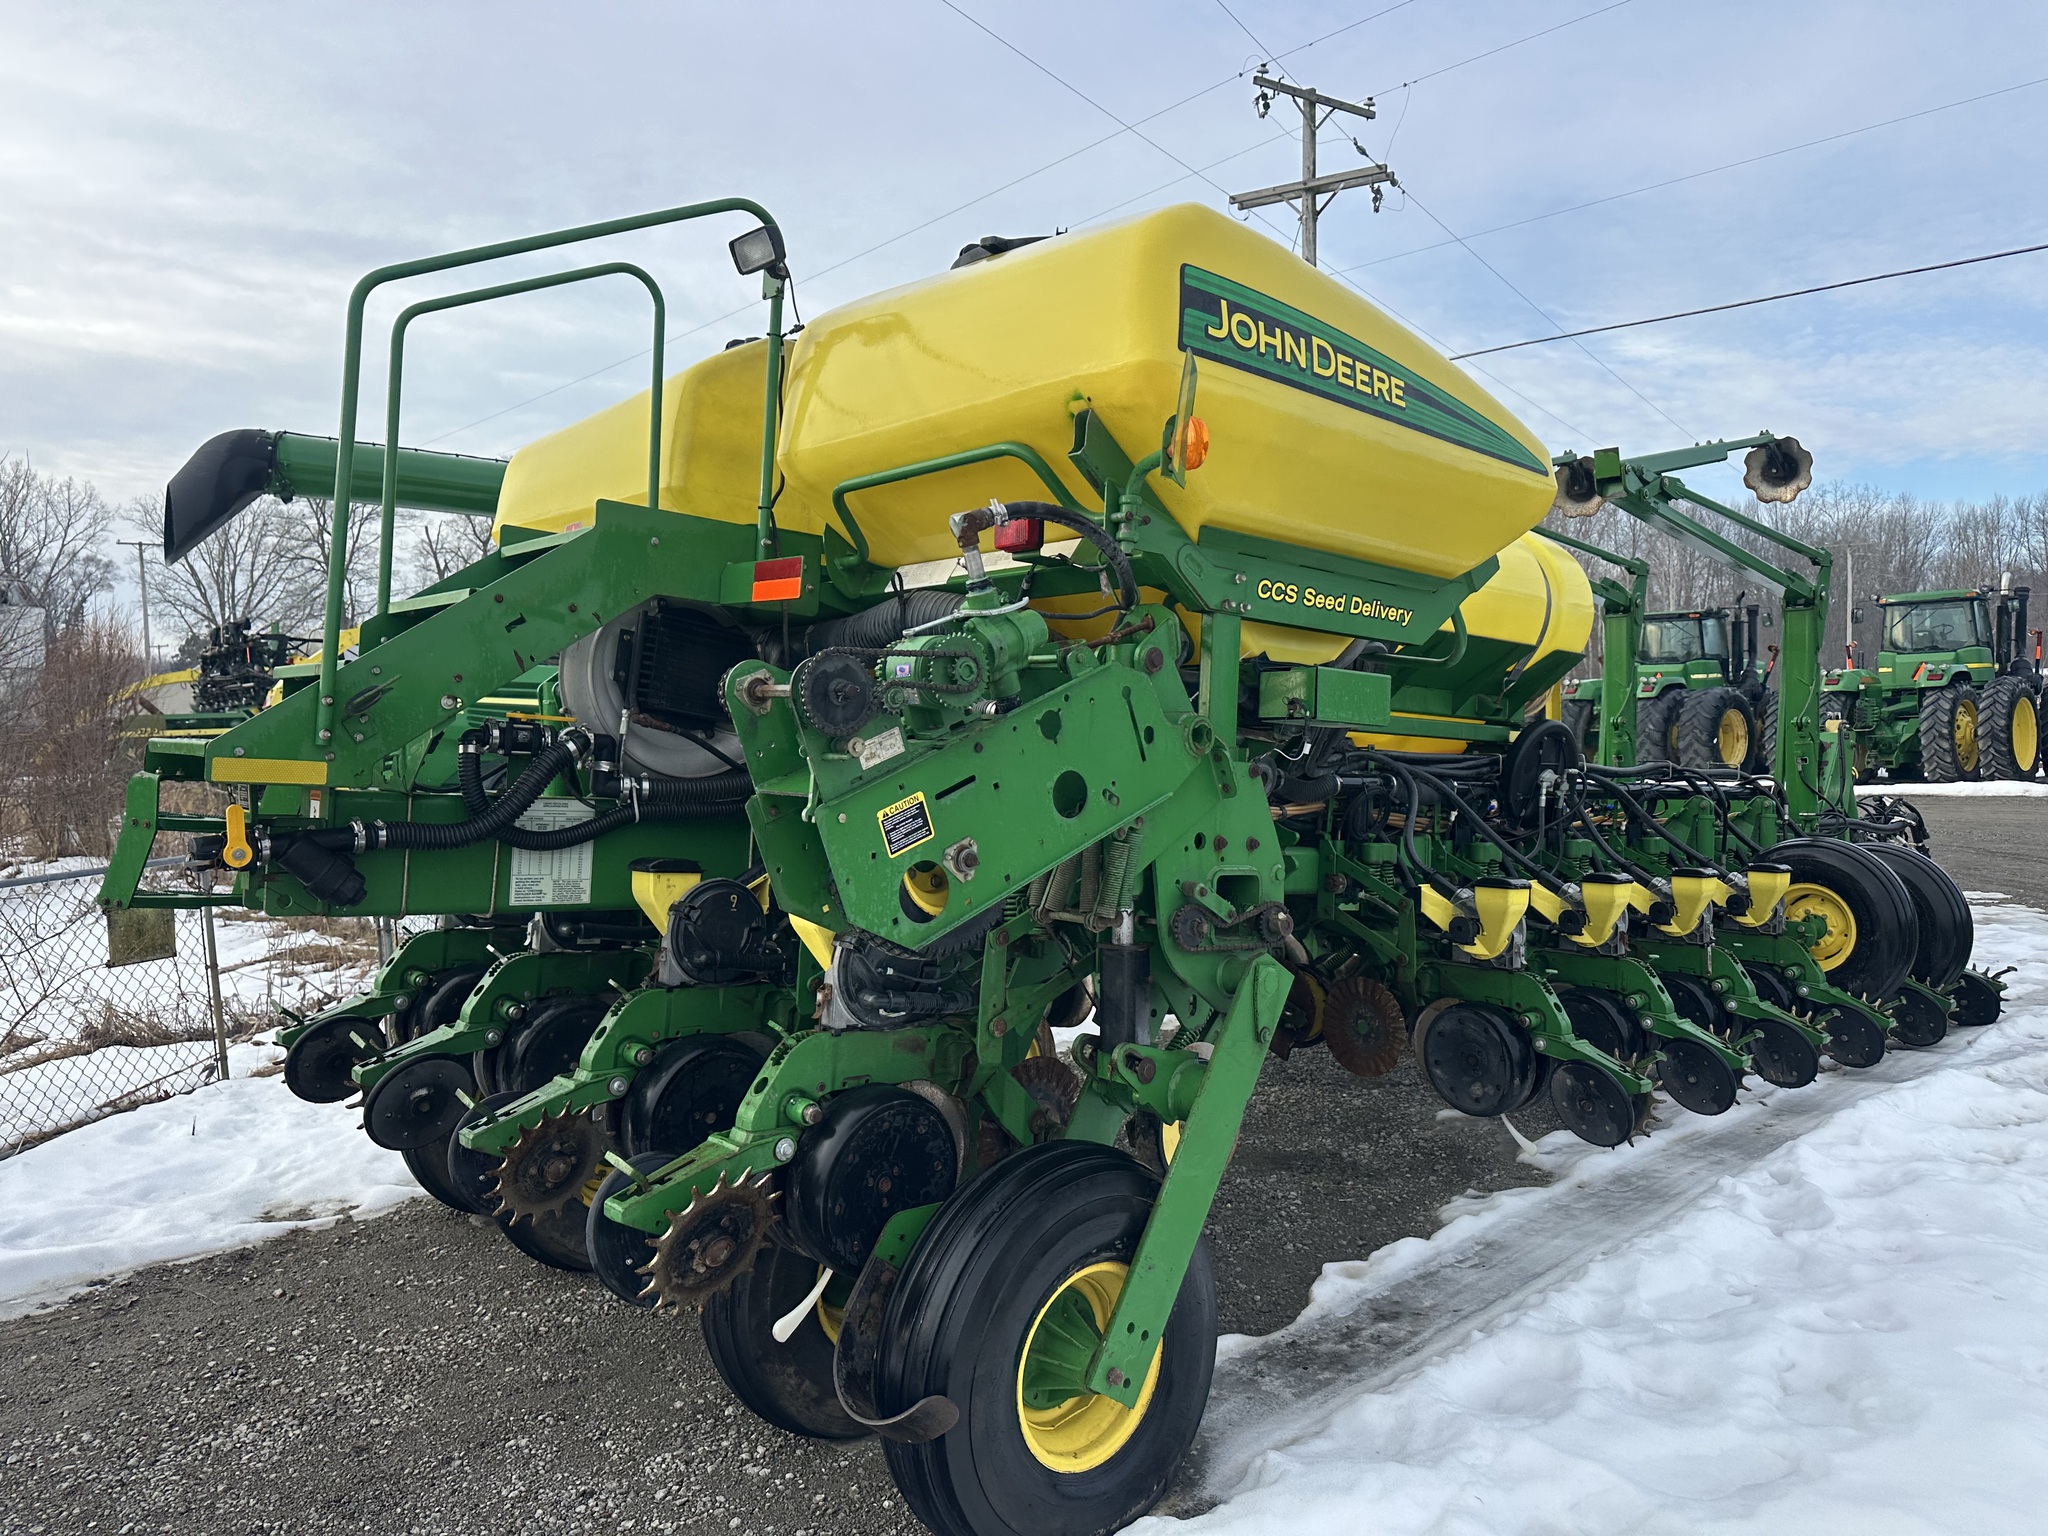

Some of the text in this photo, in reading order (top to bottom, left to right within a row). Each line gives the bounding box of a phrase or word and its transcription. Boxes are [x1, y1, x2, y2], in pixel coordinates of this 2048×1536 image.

[1208, 299, 1406, 408] JOHN DEERE
[1257, 579, 1413, 627] CCS Seed Delivery
[889, 796, 919, 814] CAUTION
